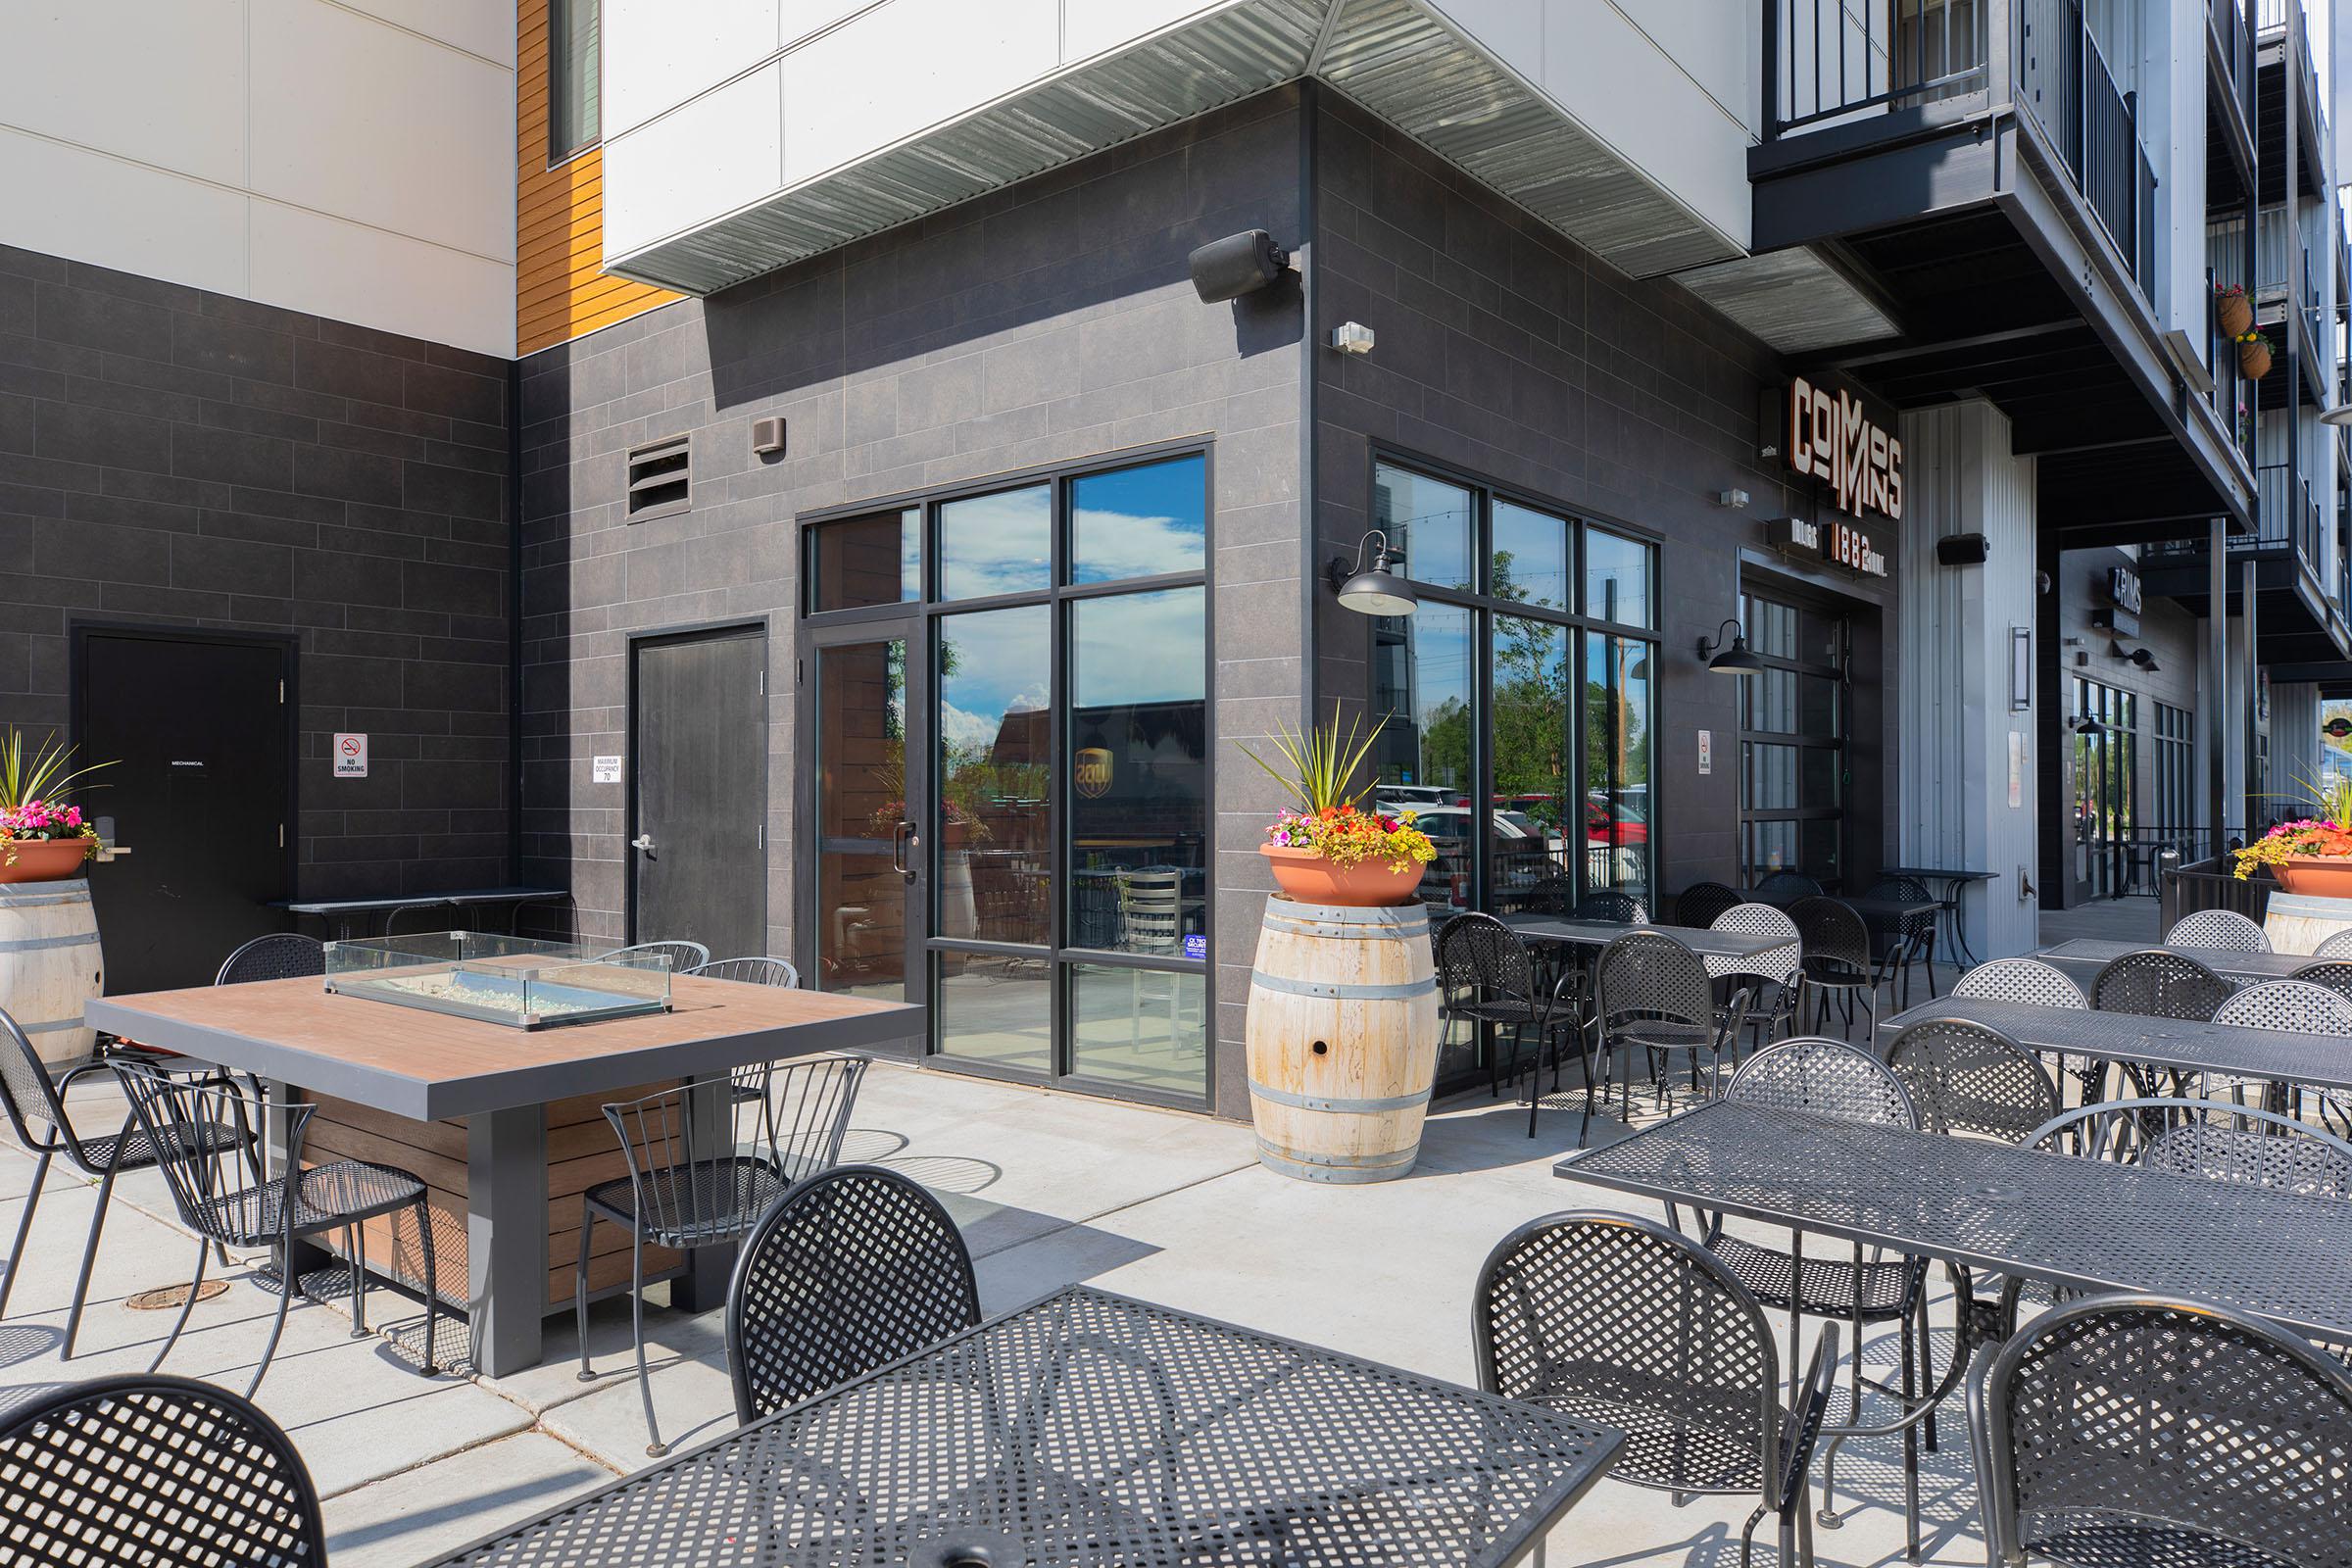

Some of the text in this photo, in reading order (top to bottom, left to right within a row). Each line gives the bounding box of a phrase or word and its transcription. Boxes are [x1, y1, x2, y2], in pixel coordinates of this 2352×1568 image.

[1792, 376, 1902, 520] COMMONS
[1832, 521, 1870, 572] 1882
[604, 772, 612, 781] 70
